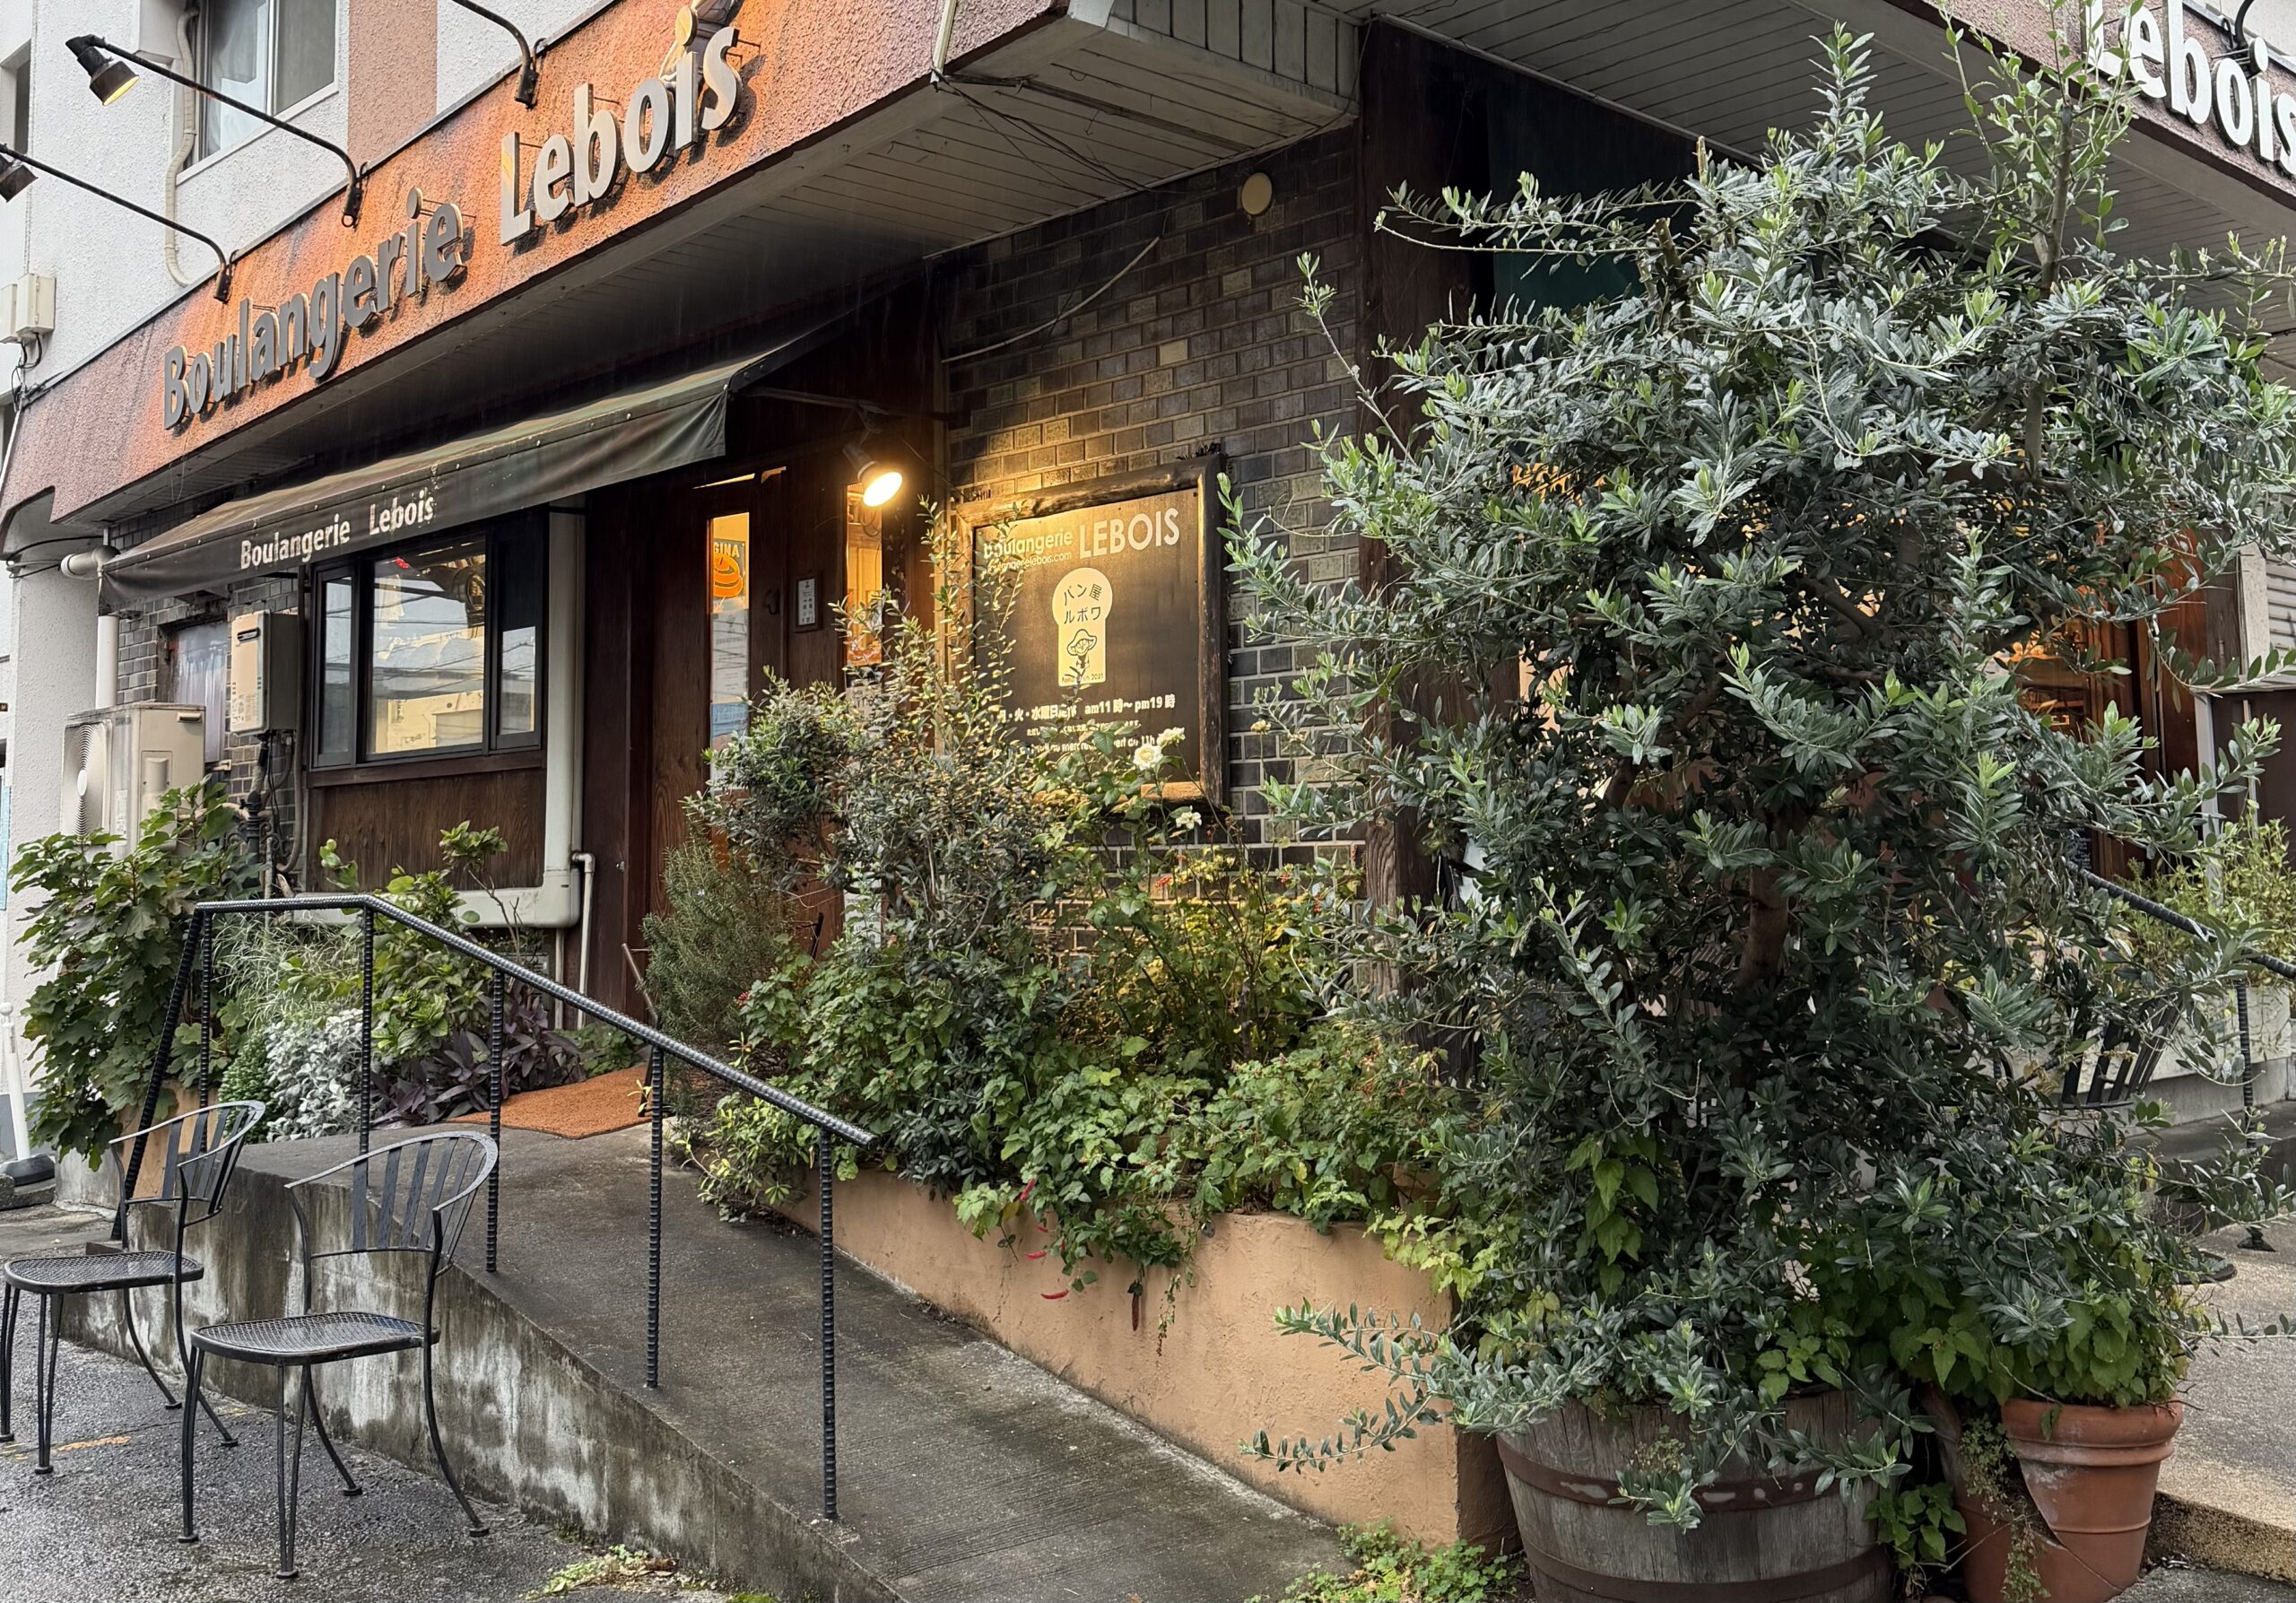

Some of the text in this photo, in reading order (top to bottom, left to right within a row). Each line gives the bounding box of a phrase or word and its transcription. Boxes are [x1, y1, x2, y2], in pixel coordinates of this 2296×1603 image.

[164, 4, 741, 431] Boulangerie Lebois
[240, 488, 434, 570] Boulangerie Lebois
[1079, 507, 1180, 560] LEBOIS
[1064, 583, 1102, 606] パン屋
[1064, 606, 1101, 624] ルボワ
